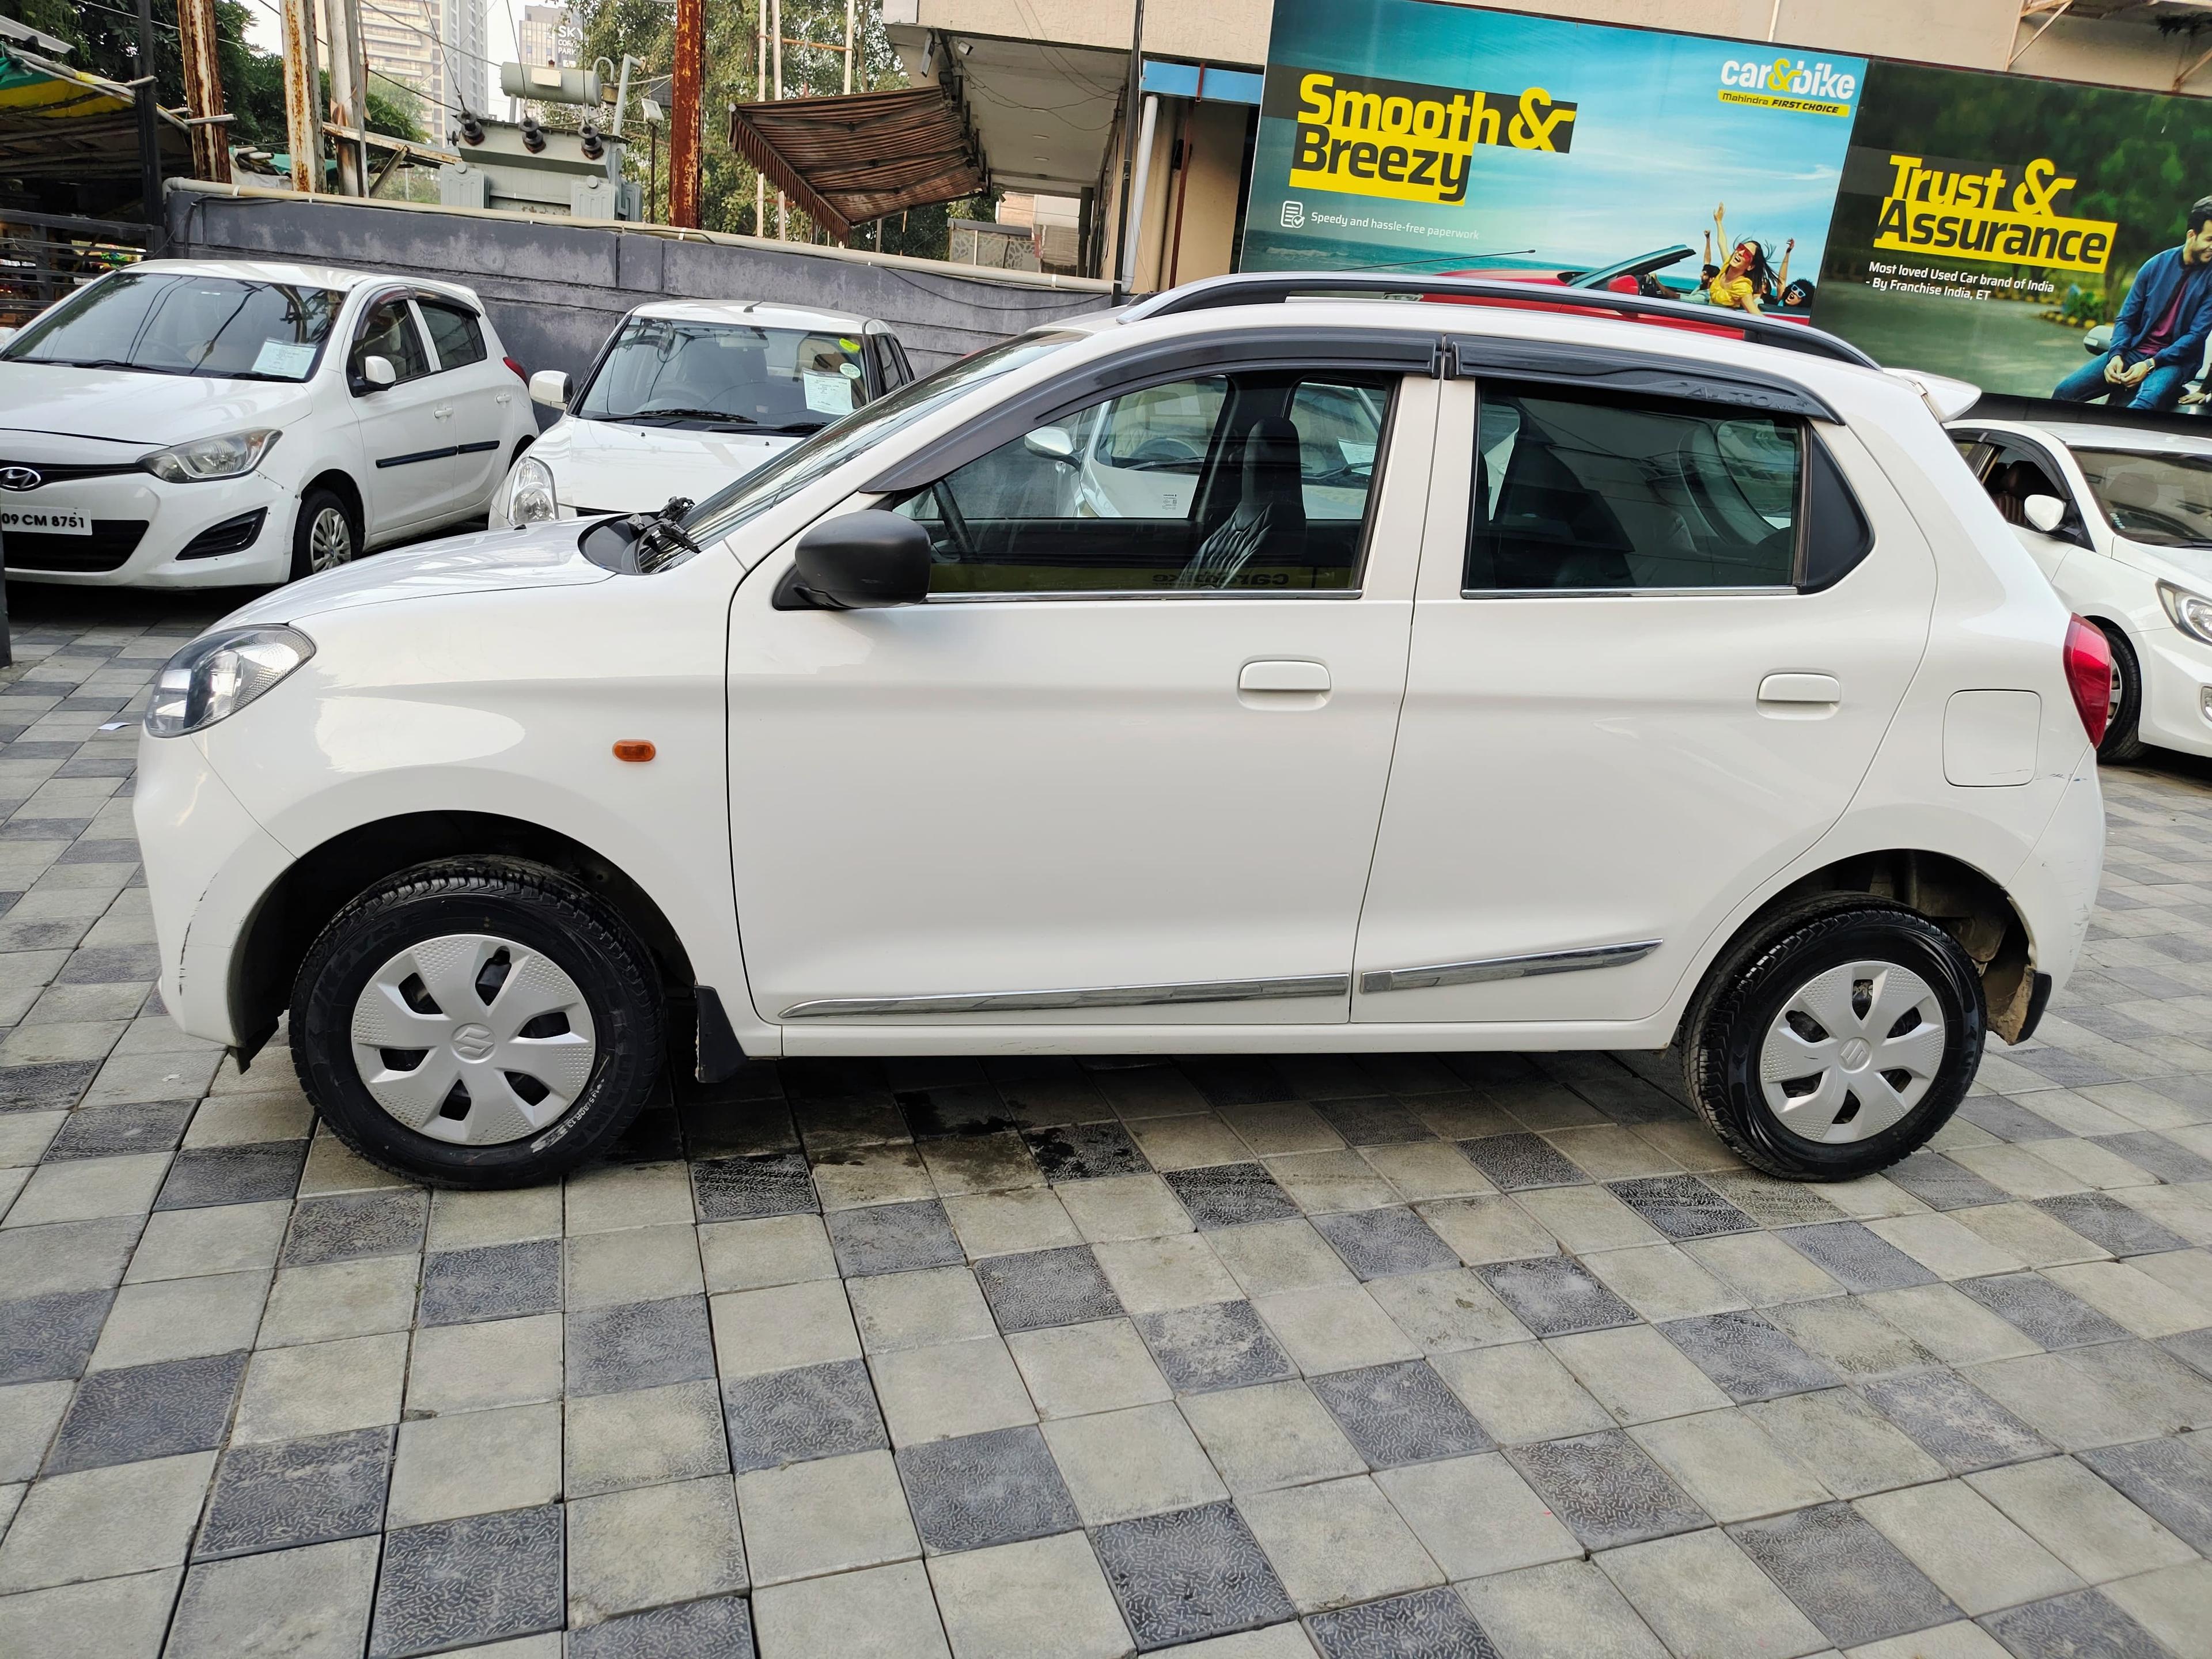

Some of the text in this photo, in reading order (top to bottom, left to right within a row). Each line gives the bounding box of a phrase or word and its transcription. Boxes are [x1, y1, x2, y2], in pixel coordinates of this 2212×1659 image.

[1720, 58, 1855, 100] car&bike
[1297, 73, 1577, 152] Smooth &
[1722, 92, 1839, 113] Mahindra FIRST CHOICE
[1292, 122, 1472, 202] Breezy
[1889, 154, 2077, 217] Trust &
[1310, 212, 1479, 240] Speedy and hassle-free paperwork
[1874, 199, 2107, 264] Assurance
[1869, 261, 2055, 293] Most loved Used Car brand of India
[1872, 277, 1887, 291] By
[1889, 279, 1941, 296] Franchise
[1943, 286, 1973, 301] India,
[1976, 289, 1991, 301] ET
[1, 513, 84, 528] 09 CM 8751
